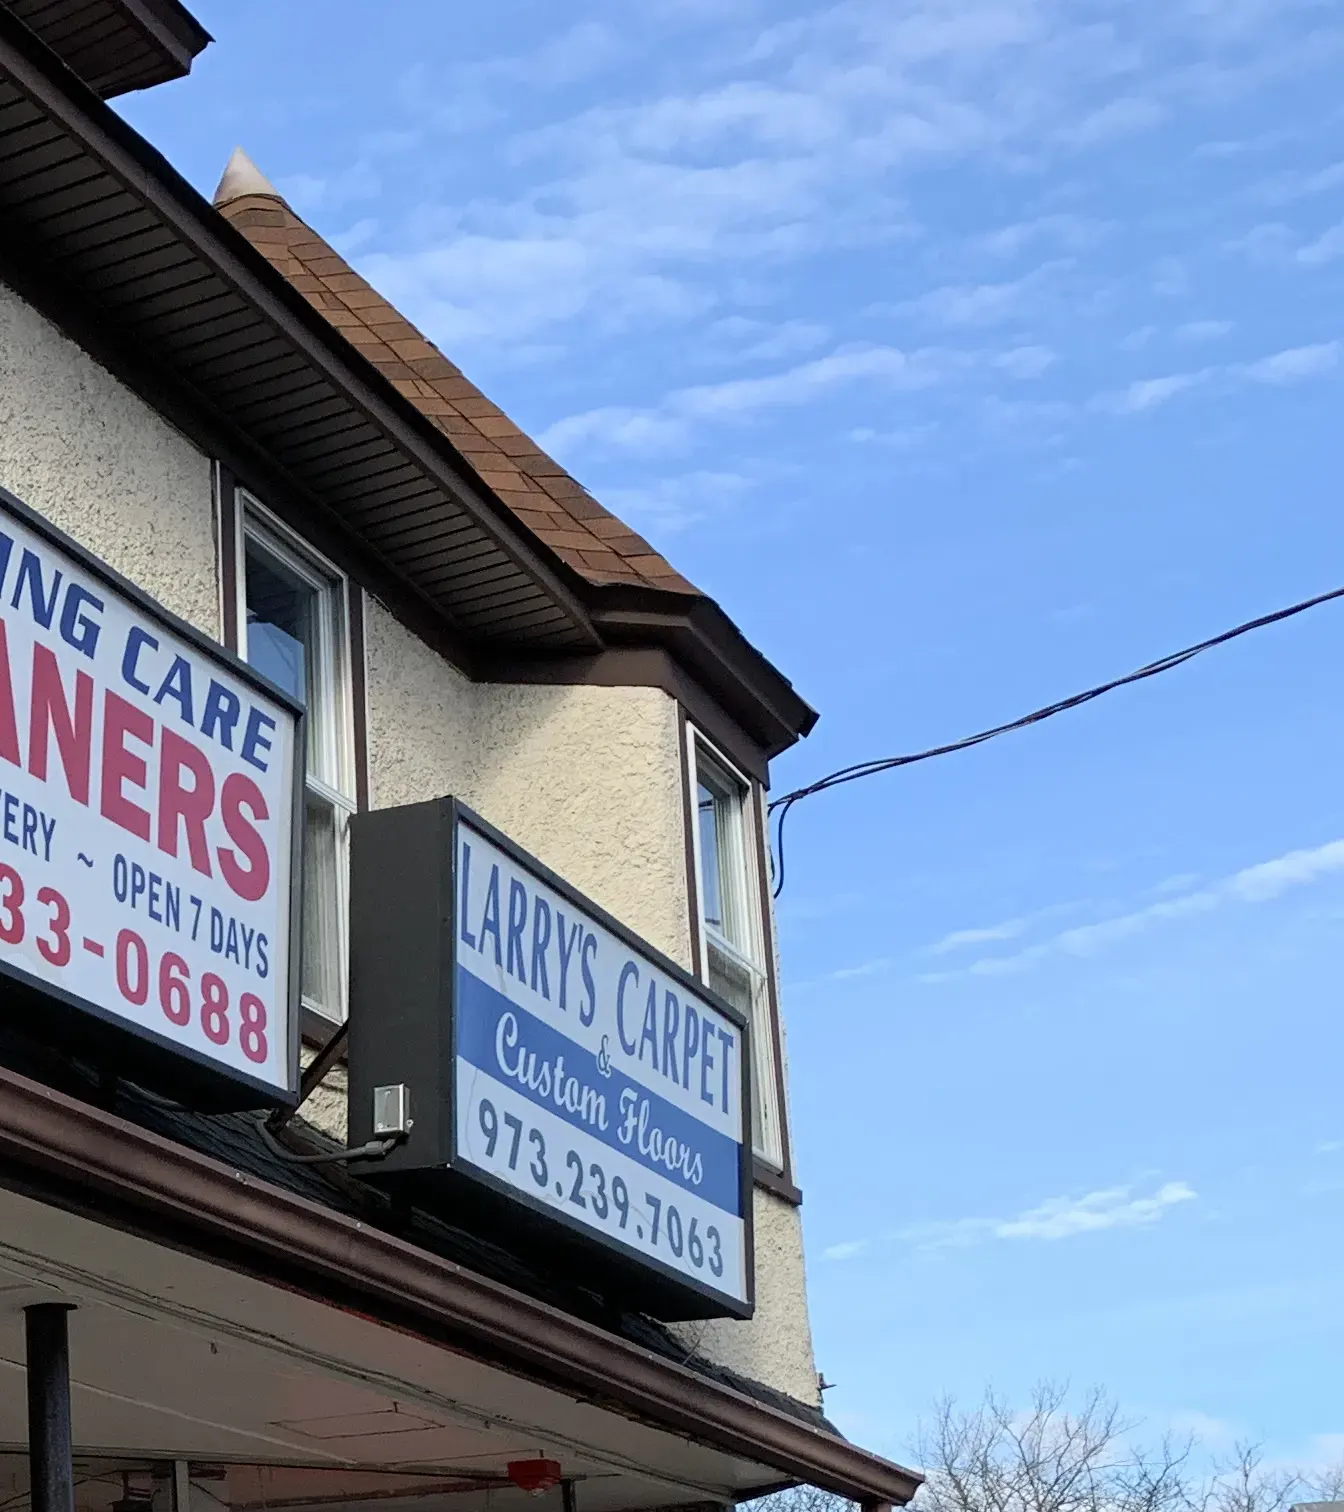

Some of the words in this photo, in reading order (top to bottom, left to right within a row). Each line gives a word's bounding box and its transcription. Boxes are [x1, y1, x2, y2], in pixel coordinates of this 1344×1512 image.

[122, 625, 276, 773] CARE
[113, 854, 181, 930] OPEN
[190, 897, 203, 940] 7
[210, 906, 269, 979] DAYS
[461, 842, 598, 1028] LARRY'S
[616, 961, 734, 1116] CARPET
[495, 1011, 609, 1133] Custom
[616, 1086, 704, 1186] Floors
[596, 1034, 612, 1079] &
[478, 1098, 723, 1279] 973.239.7063
